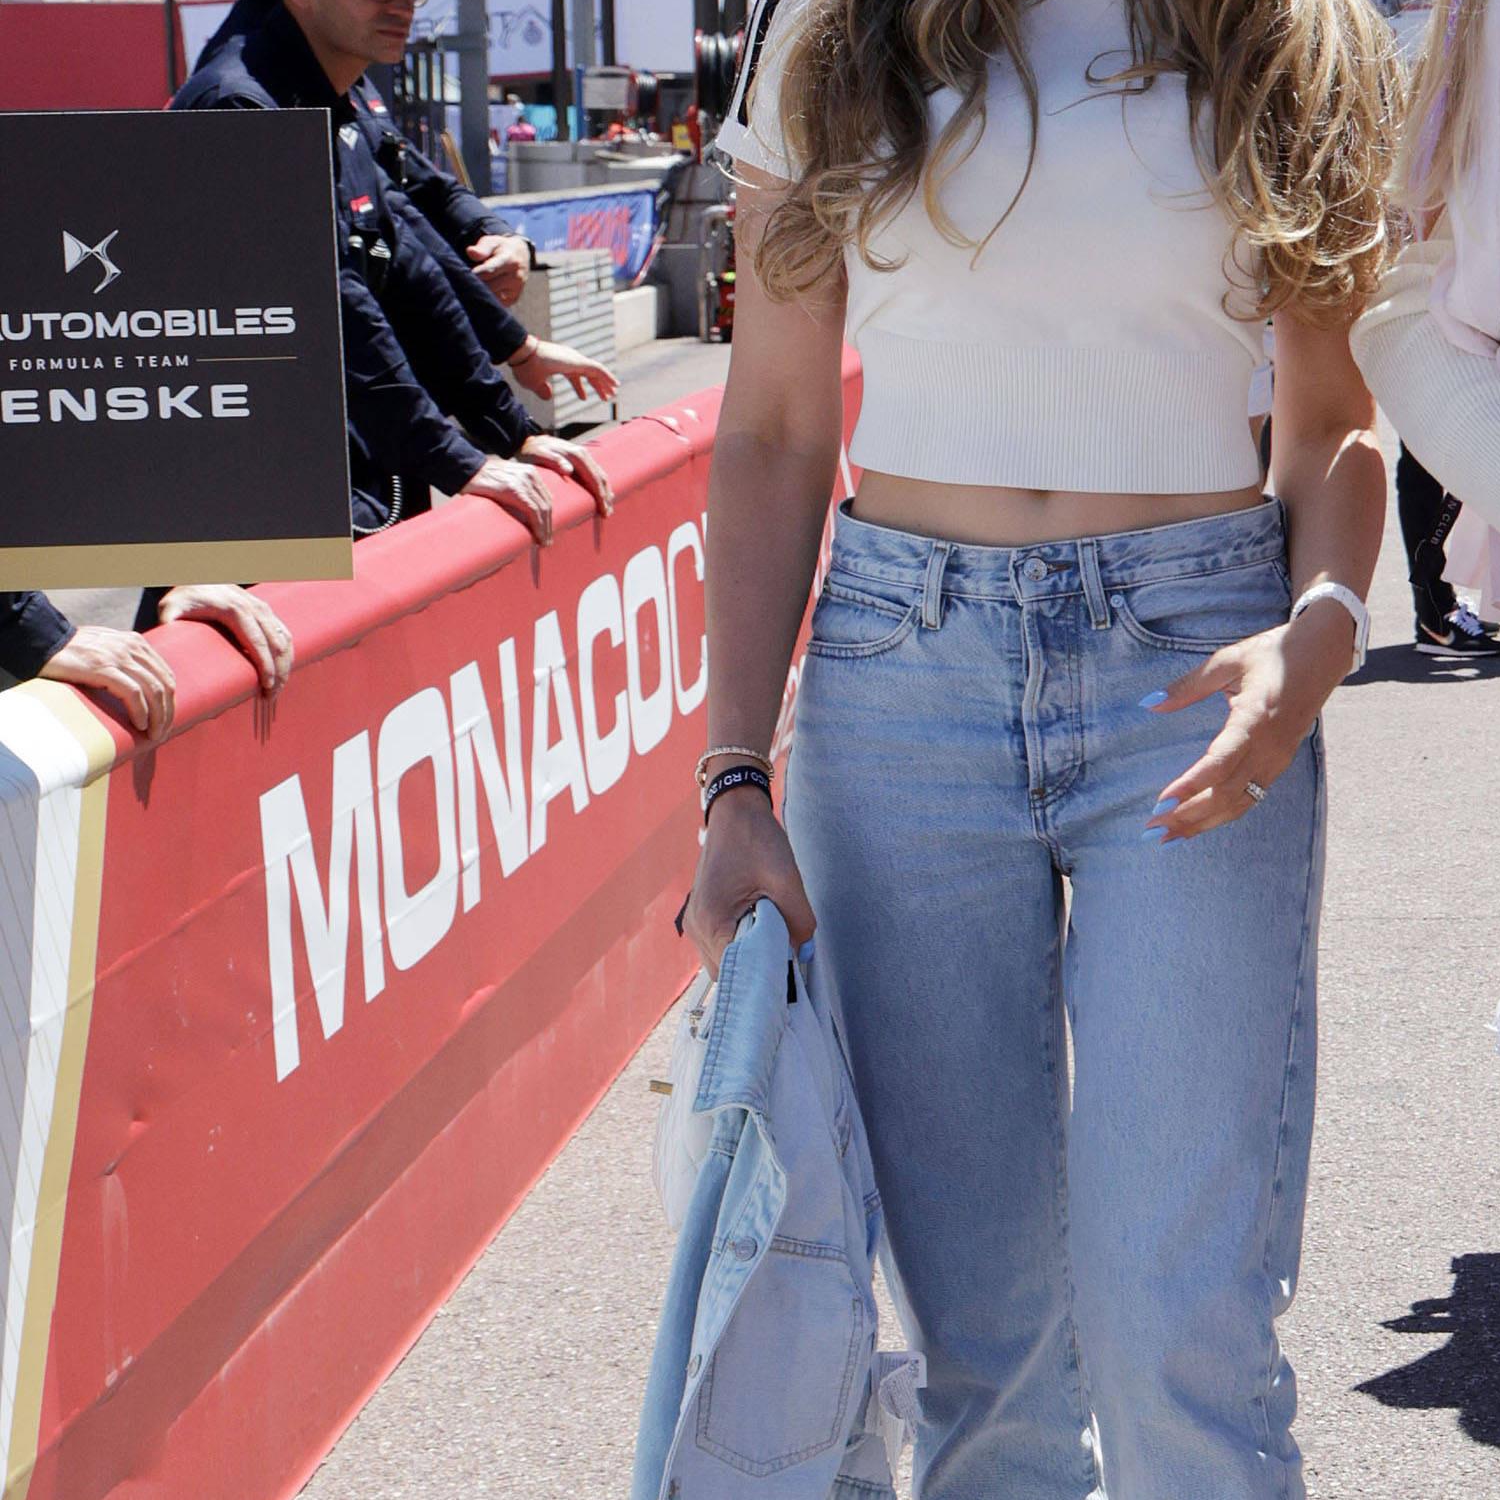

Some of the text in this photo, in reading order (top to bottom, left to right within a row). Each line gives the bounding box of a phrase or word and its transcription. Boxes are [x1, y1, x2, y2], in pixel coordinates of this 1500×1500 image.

[0, 306, 297, 342] UTOMOBILES
[9, 354, 190, 372] FORMULA E TEAM
[0, 383, 251, 424] ENSKE
